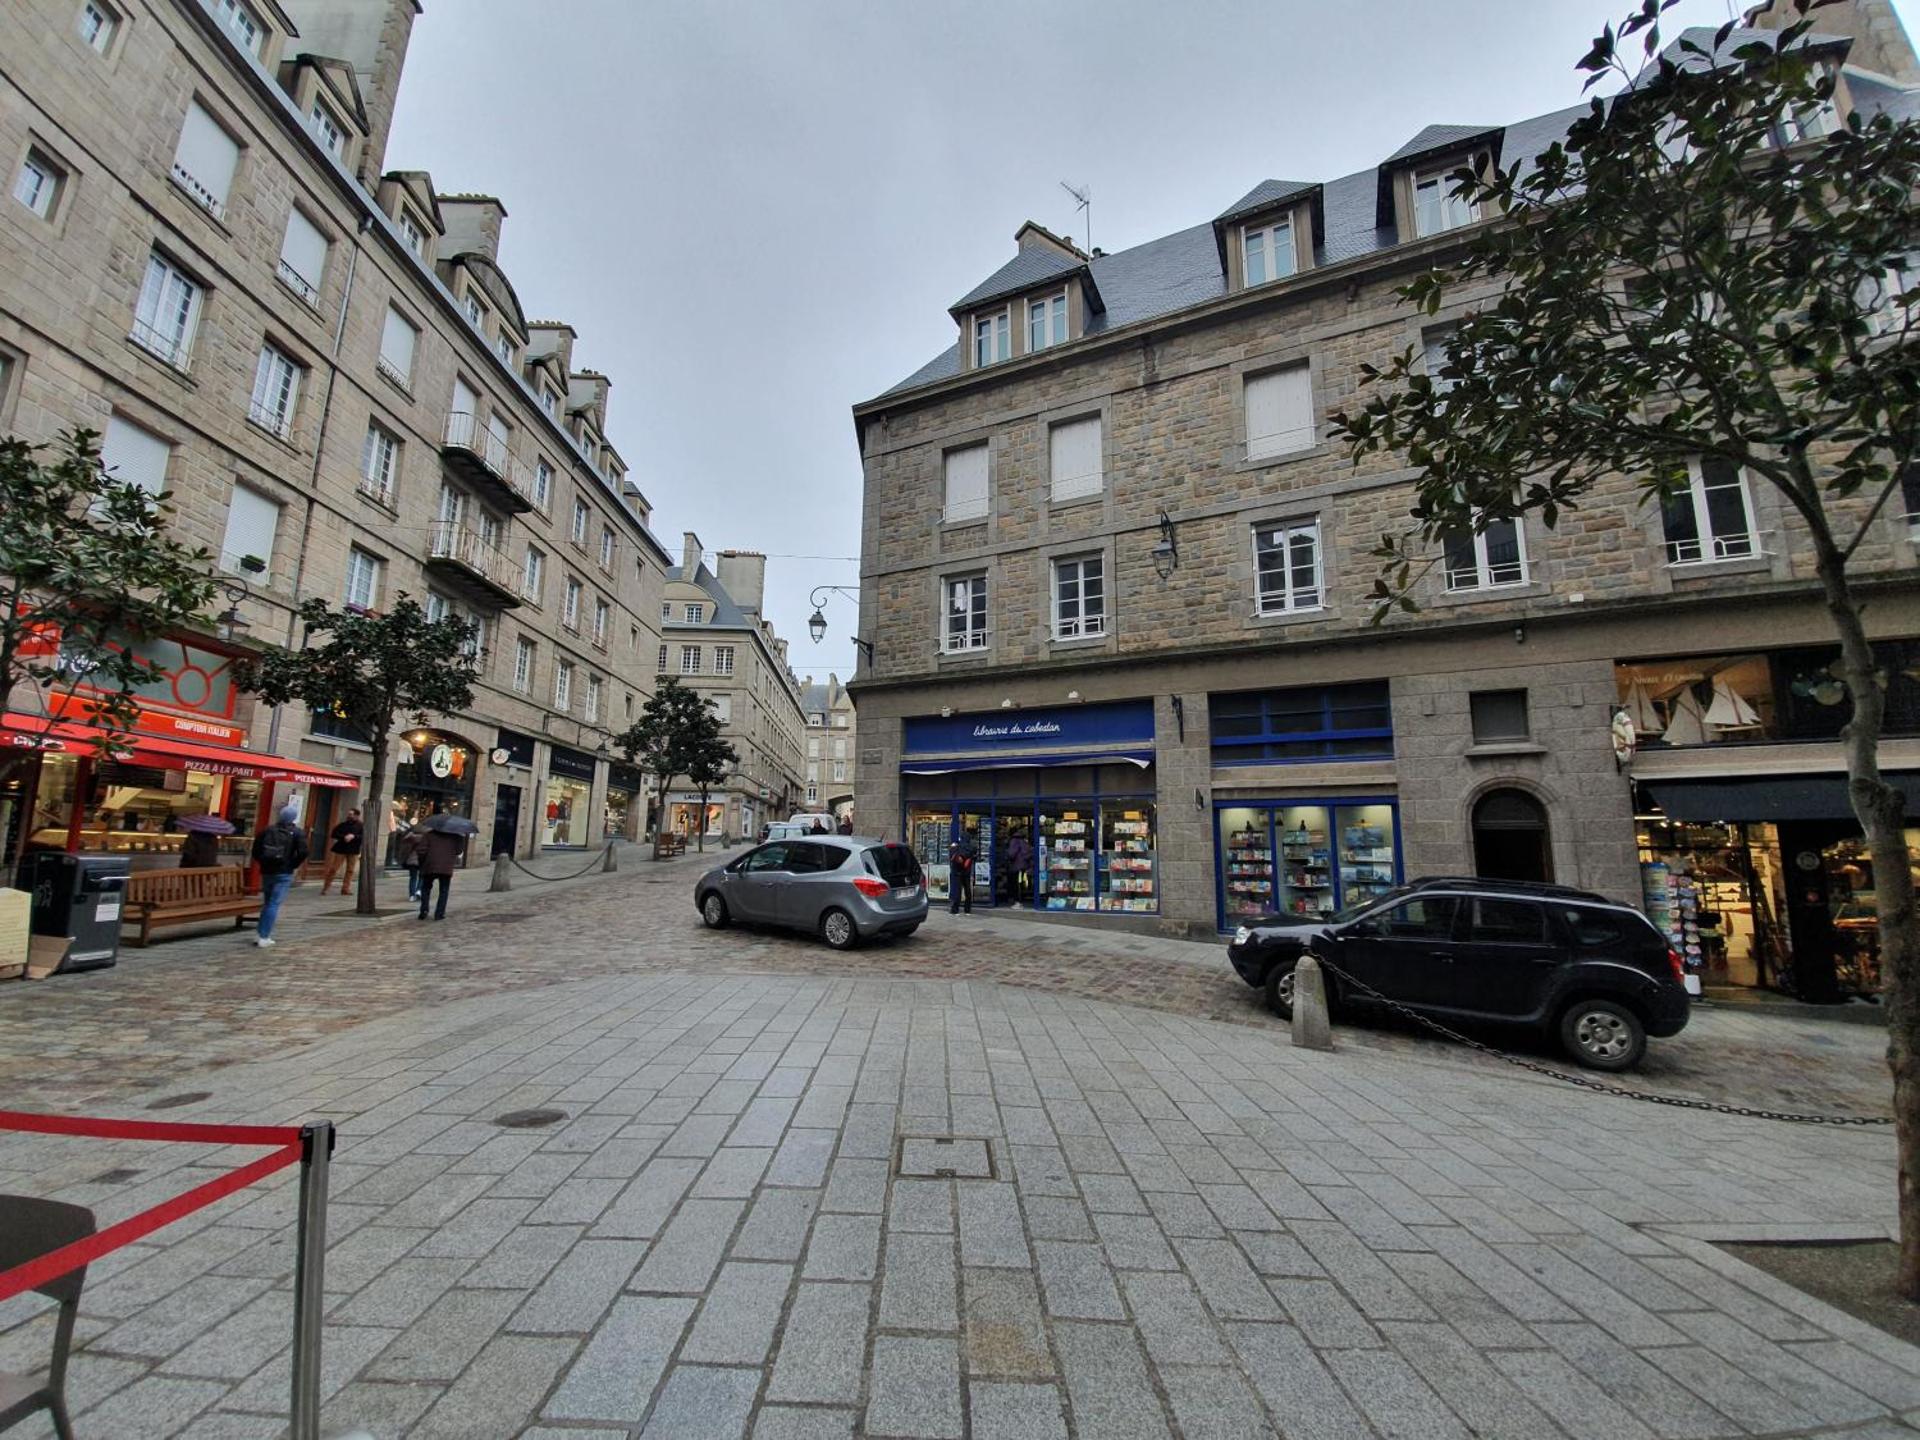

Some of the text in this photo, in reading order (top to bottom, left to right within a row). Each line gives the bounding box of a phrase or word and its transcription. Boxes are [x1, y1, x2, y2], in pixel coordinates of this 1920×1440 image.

[1009, 722, 1023, 734] du
[184, 760, 211, 772] PIZZA
[220, 765, 231, 774] LA
[231, 767, 254, 777] PART
